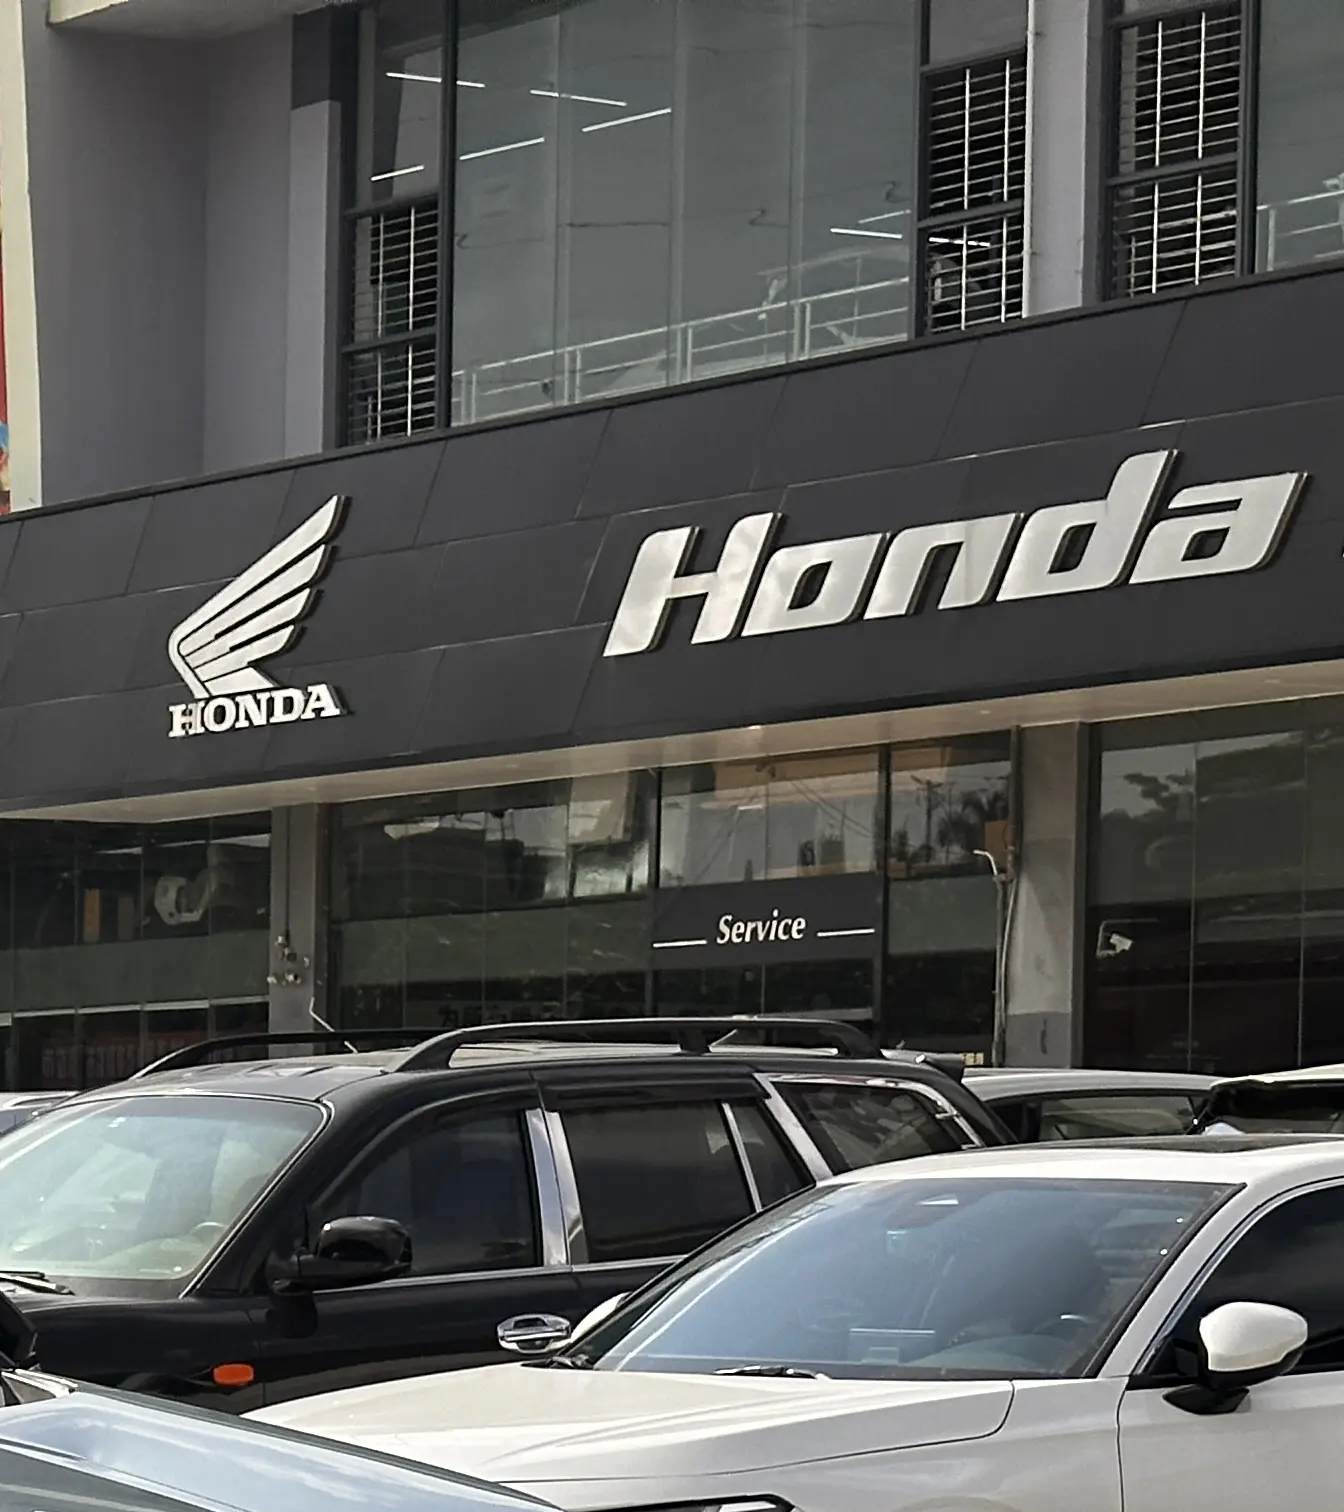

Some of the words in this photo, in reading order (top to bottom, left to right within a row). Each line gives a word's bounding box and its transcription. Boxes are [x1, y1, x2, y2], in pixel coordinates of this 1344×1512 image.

[602, 449, 1308, 657] Honda
[168, 683, 341, 738] HONDA
[716, 908, 807, 944] Service
